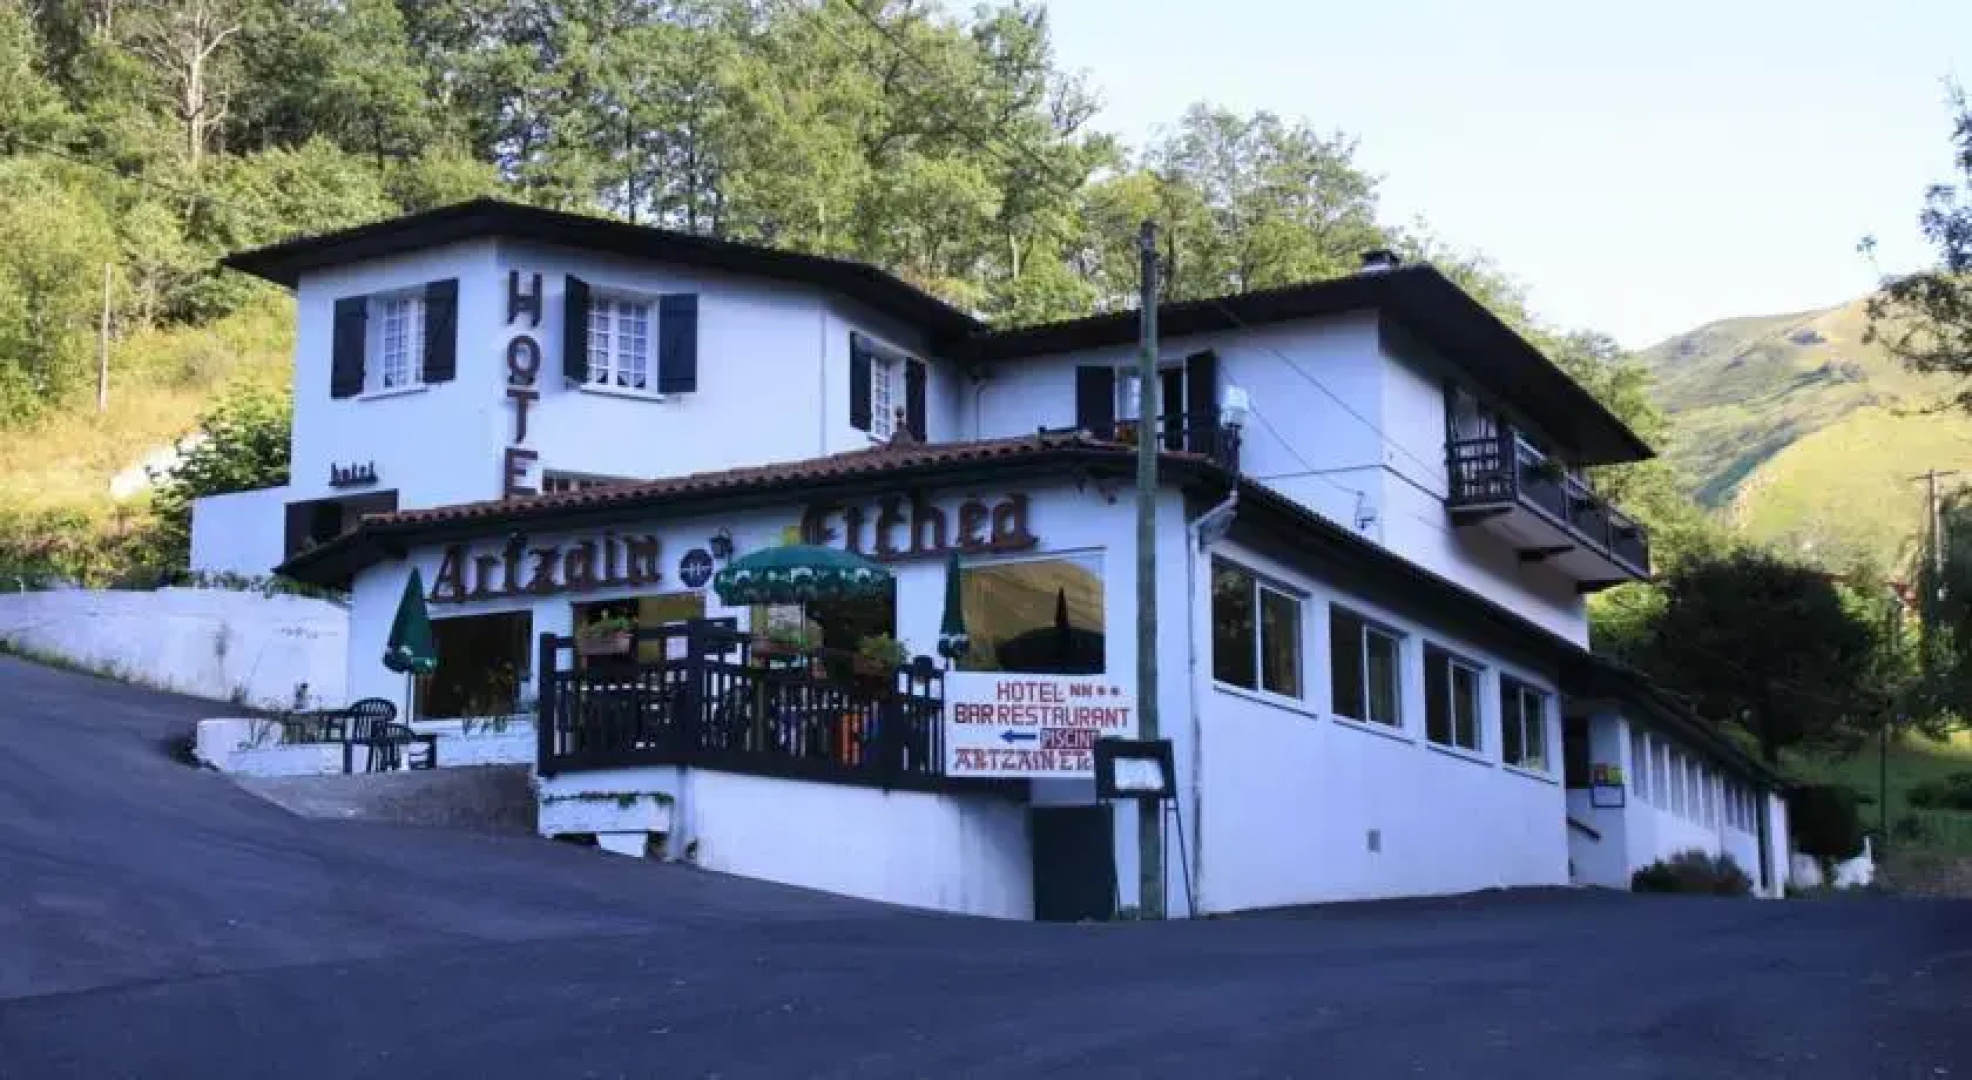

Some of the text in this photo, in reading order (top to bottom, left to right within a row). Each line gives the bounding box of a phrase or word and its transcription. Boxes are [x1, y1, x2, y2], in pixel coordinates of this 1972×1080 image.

[506, 269, 542, 500] HOTE
[423, 529, 662, 603] Artzain
[996, 680, 1066, 702] HOTEL
[954, 703, 1130, 728] BAR RESTAURANT
[954, 749, 1054, 771] ARTZAIN
